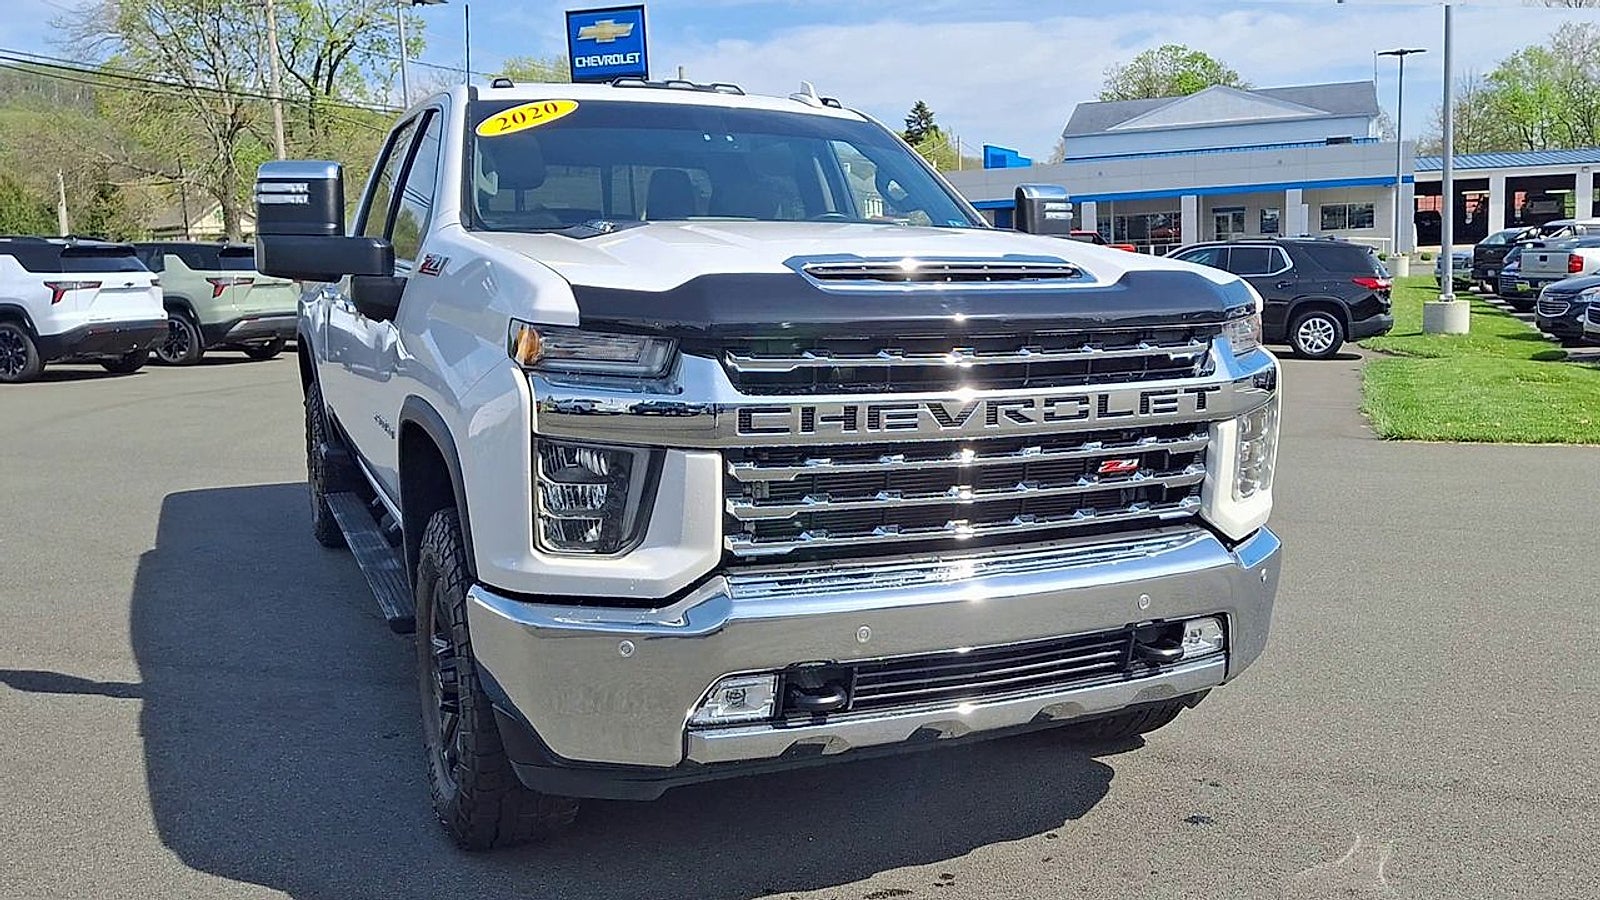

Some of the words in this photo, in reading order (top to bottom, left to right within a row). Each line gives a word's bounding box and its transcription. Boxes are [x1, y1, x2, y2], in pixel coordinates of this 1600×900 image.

[575, 53, 640, 67] CHEVROLET
[496, 102, 558, 131] 2020
[735, 386, 1221, 436] CHEVROLET
